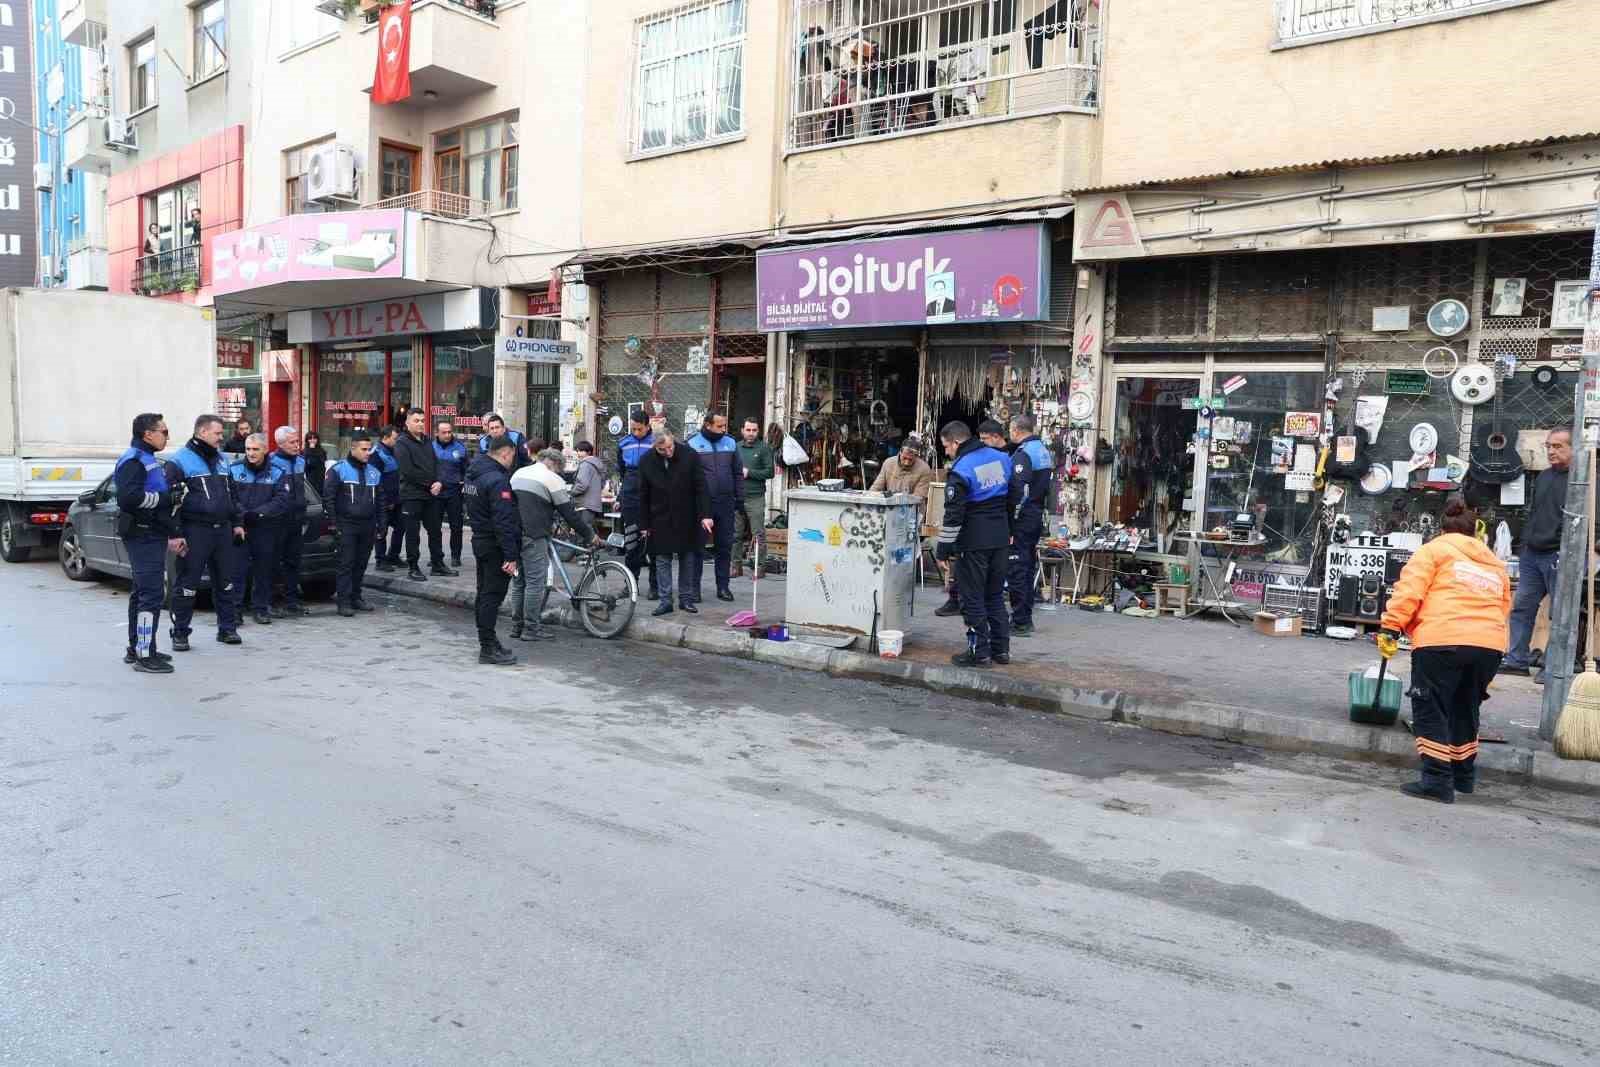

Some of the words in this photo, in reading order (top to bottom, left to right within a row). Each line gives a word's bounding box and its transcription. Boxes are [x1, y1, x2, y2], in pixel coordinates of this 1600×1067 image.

[322, 301, 431, 338] YIL-PA
[519, 342, 571, 354] PIONEER
[1355, 535, 1393, 547] TEL
[1360, 553, 1385, 568] 336
